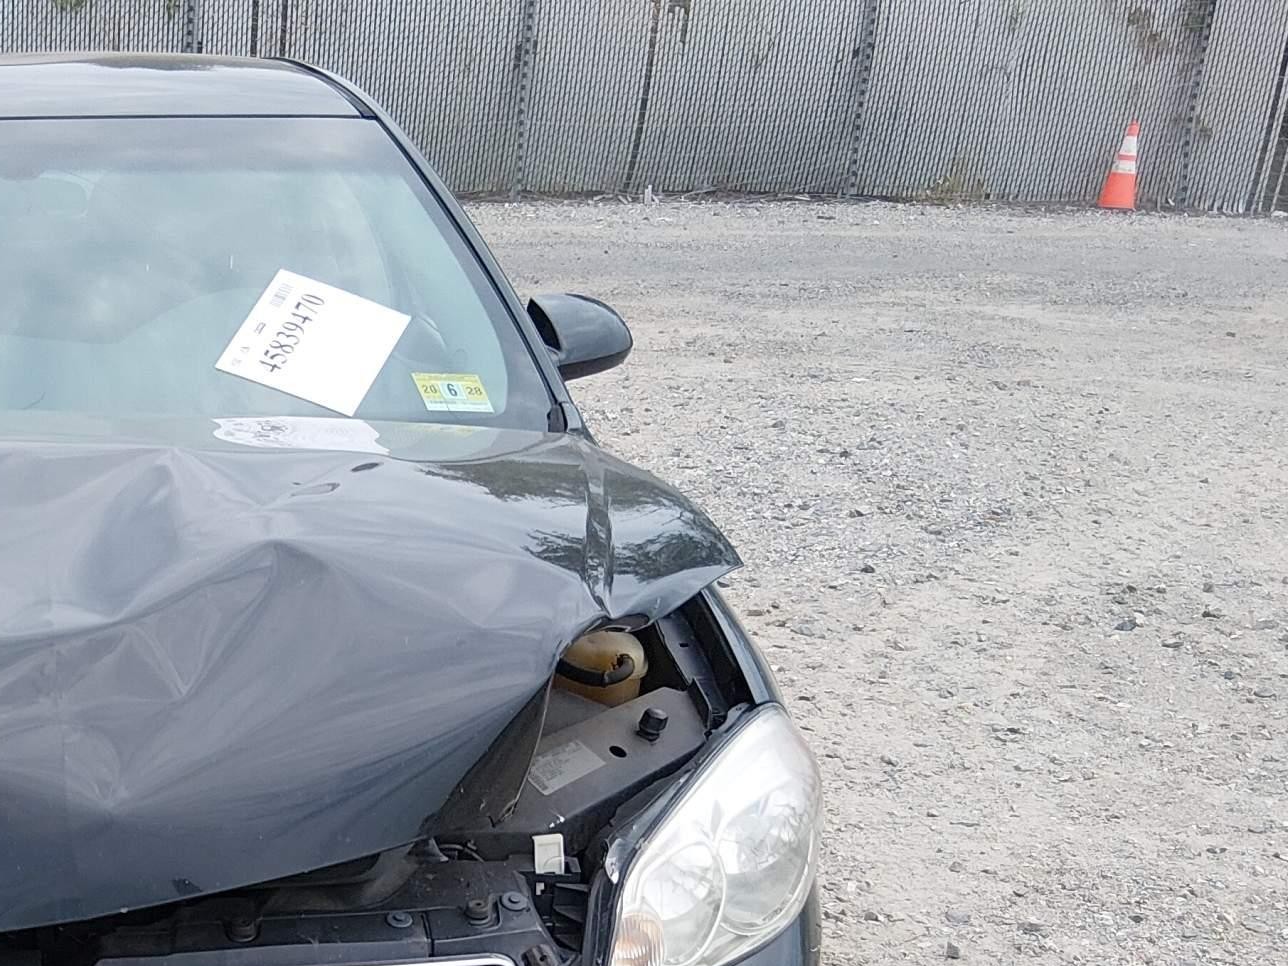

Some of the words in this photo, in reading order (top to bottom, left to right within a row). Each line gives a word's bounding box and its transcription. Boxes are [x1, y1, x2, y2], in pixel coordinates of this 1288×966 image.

[259, 293, 325, 372] 45839470
[421, 384, 438, 394] 20
[447, 383, 458, 397] 6
[465, 386, 483, 396] 28
